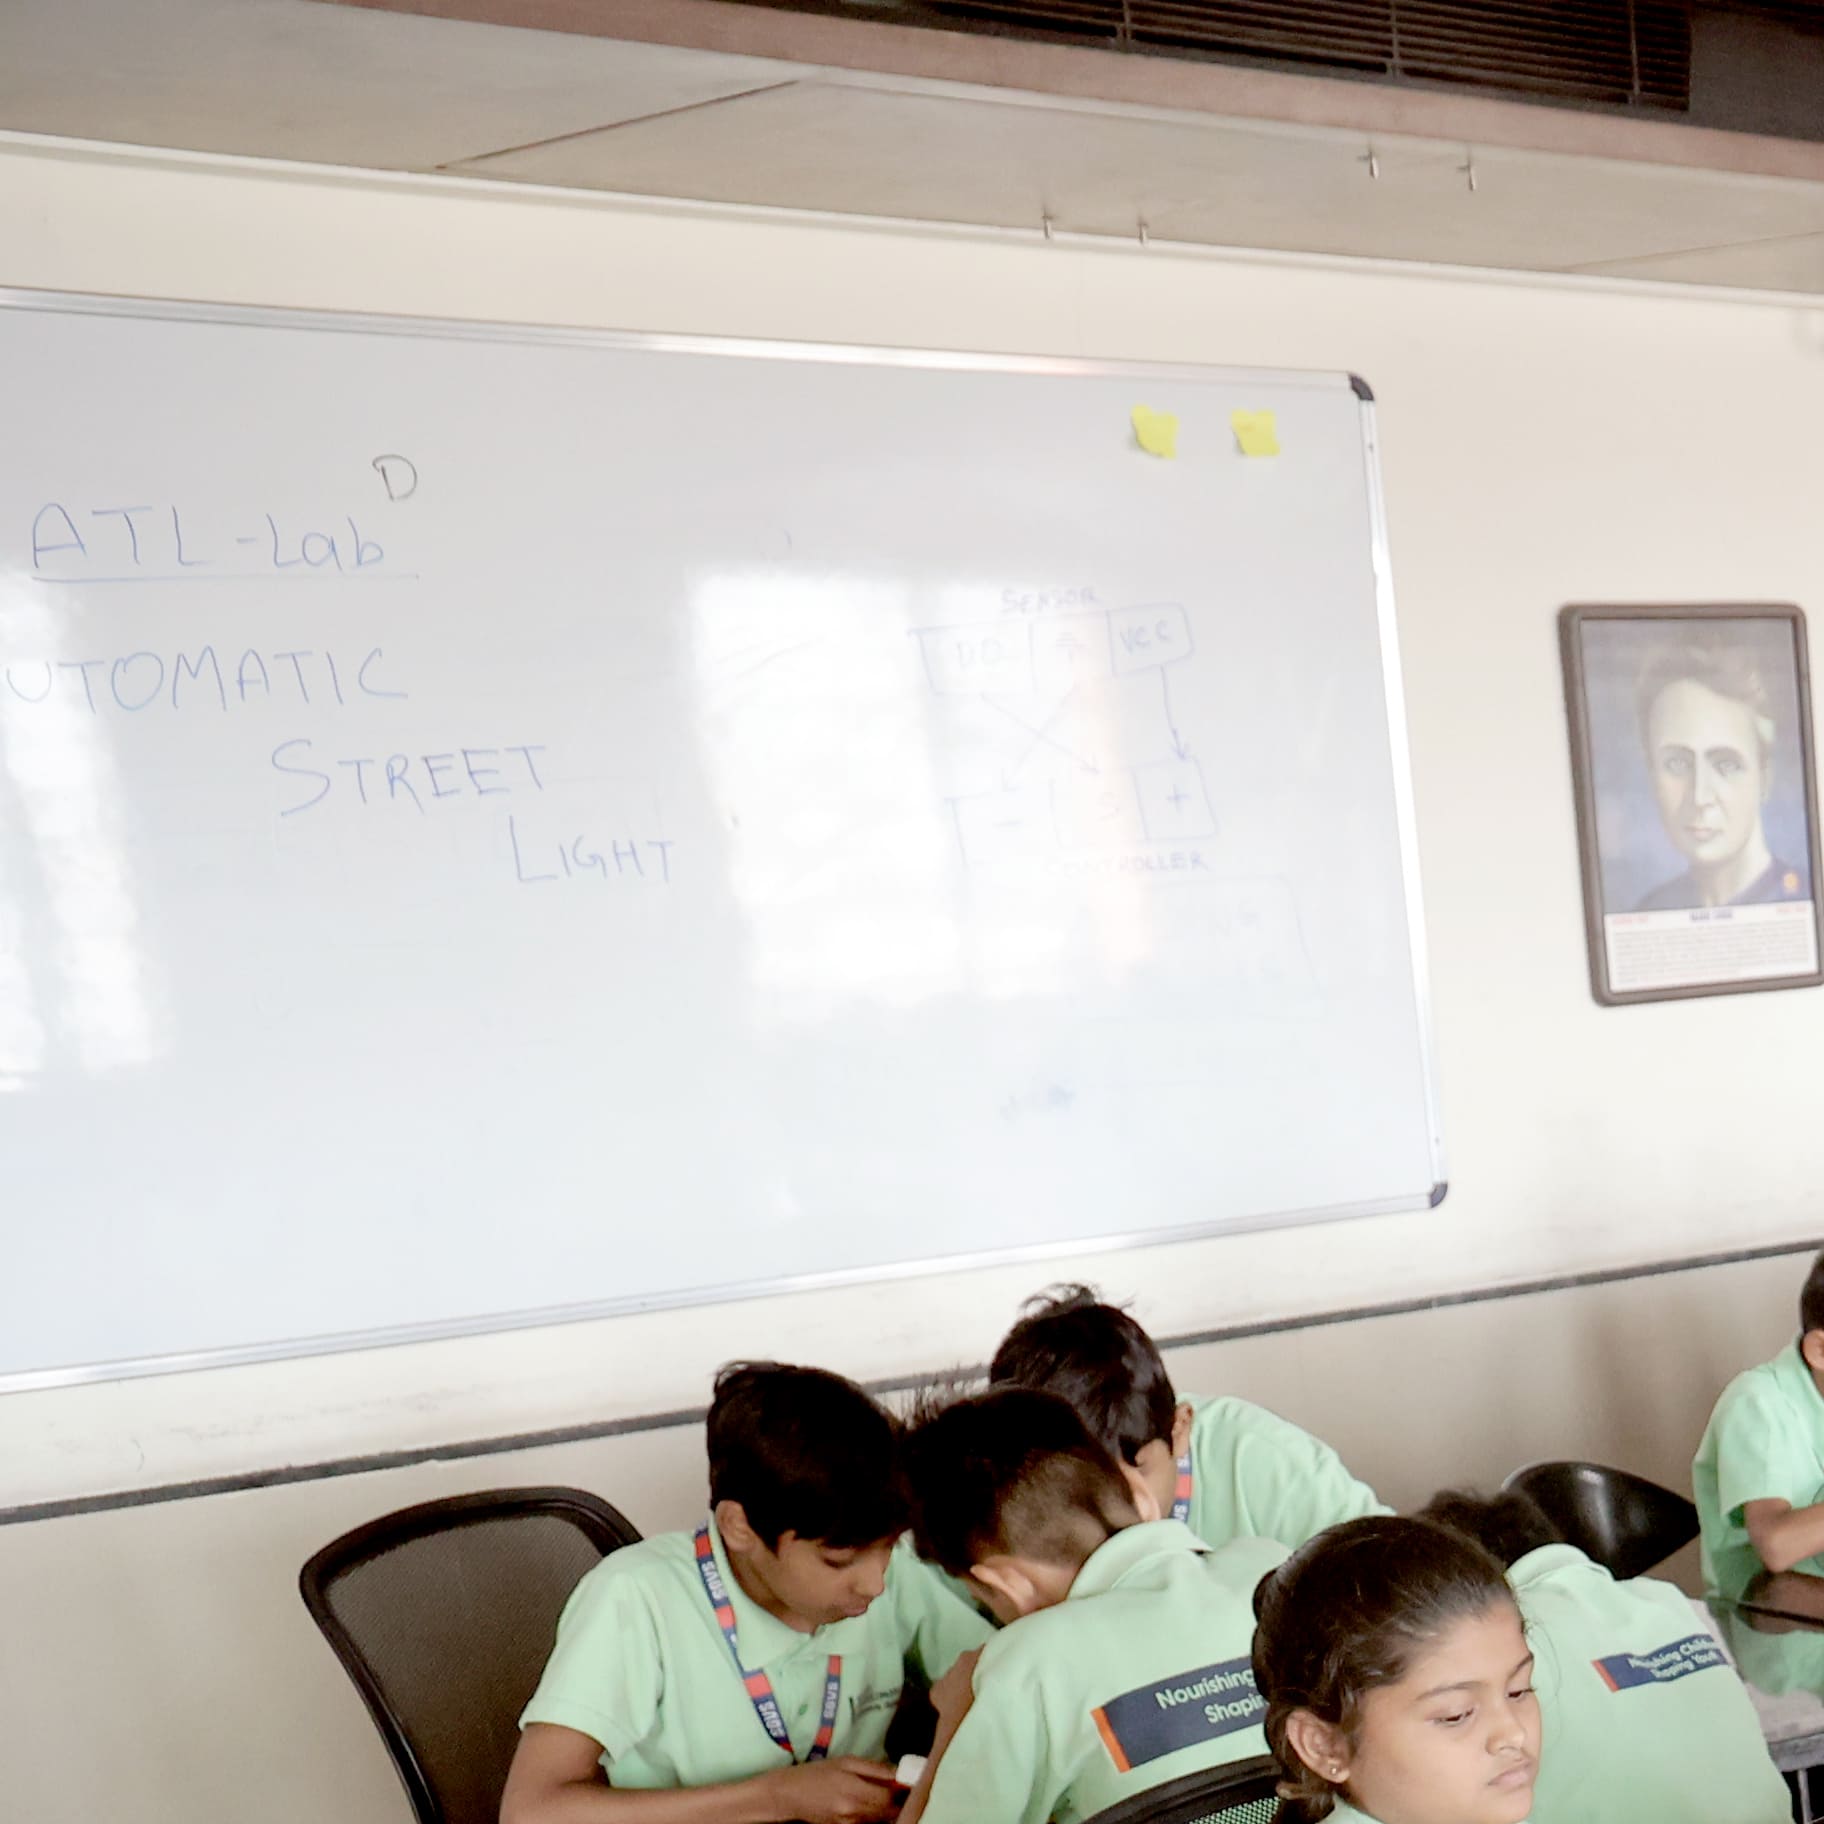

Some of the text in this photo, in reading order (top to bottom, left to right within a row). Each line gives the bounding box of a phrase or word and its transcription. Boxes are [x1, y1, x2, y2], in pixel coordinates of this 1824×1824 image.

[32, 502, 384, 572] ATL-Lab
[271, 738, 548, 817] STREET
[508, 815, 677, 883] LIGHT
